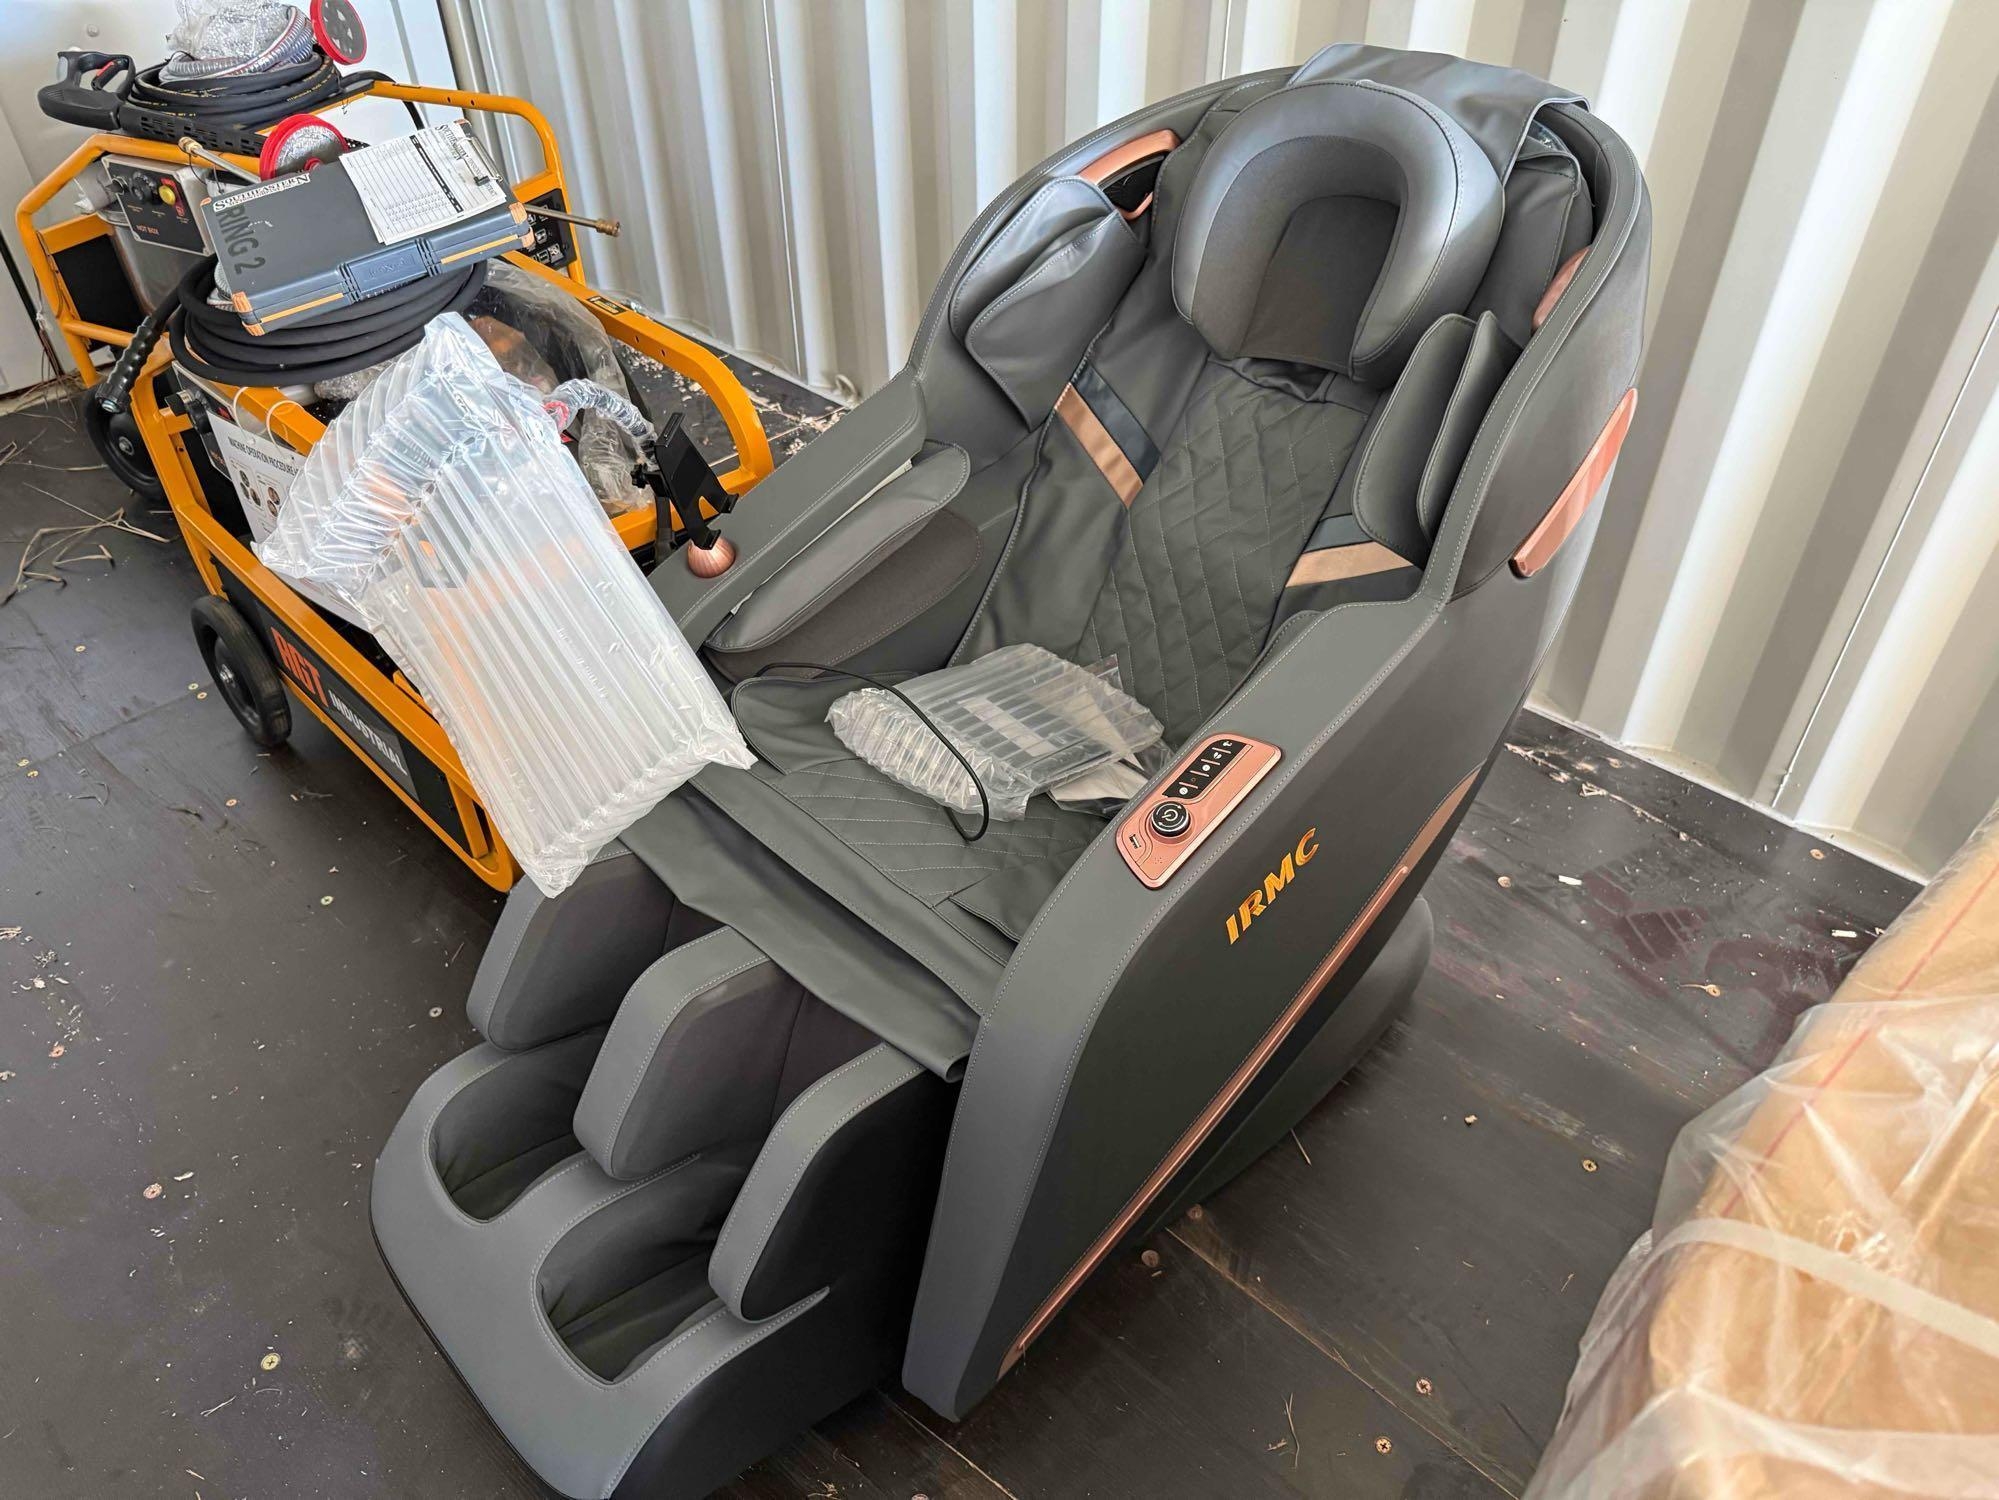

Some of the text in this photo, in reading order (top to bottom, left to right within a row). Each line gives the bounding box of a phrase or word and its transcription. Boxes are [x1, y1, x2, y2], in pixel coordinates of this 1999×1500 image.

[214, 173, 311, 211] SOUTHEASTERN
[215, 205, 266, 275] RING 2
[328, 689, 408, 776] INDUSTRIAL
[1225, 827, 1320, 945] IRMC
